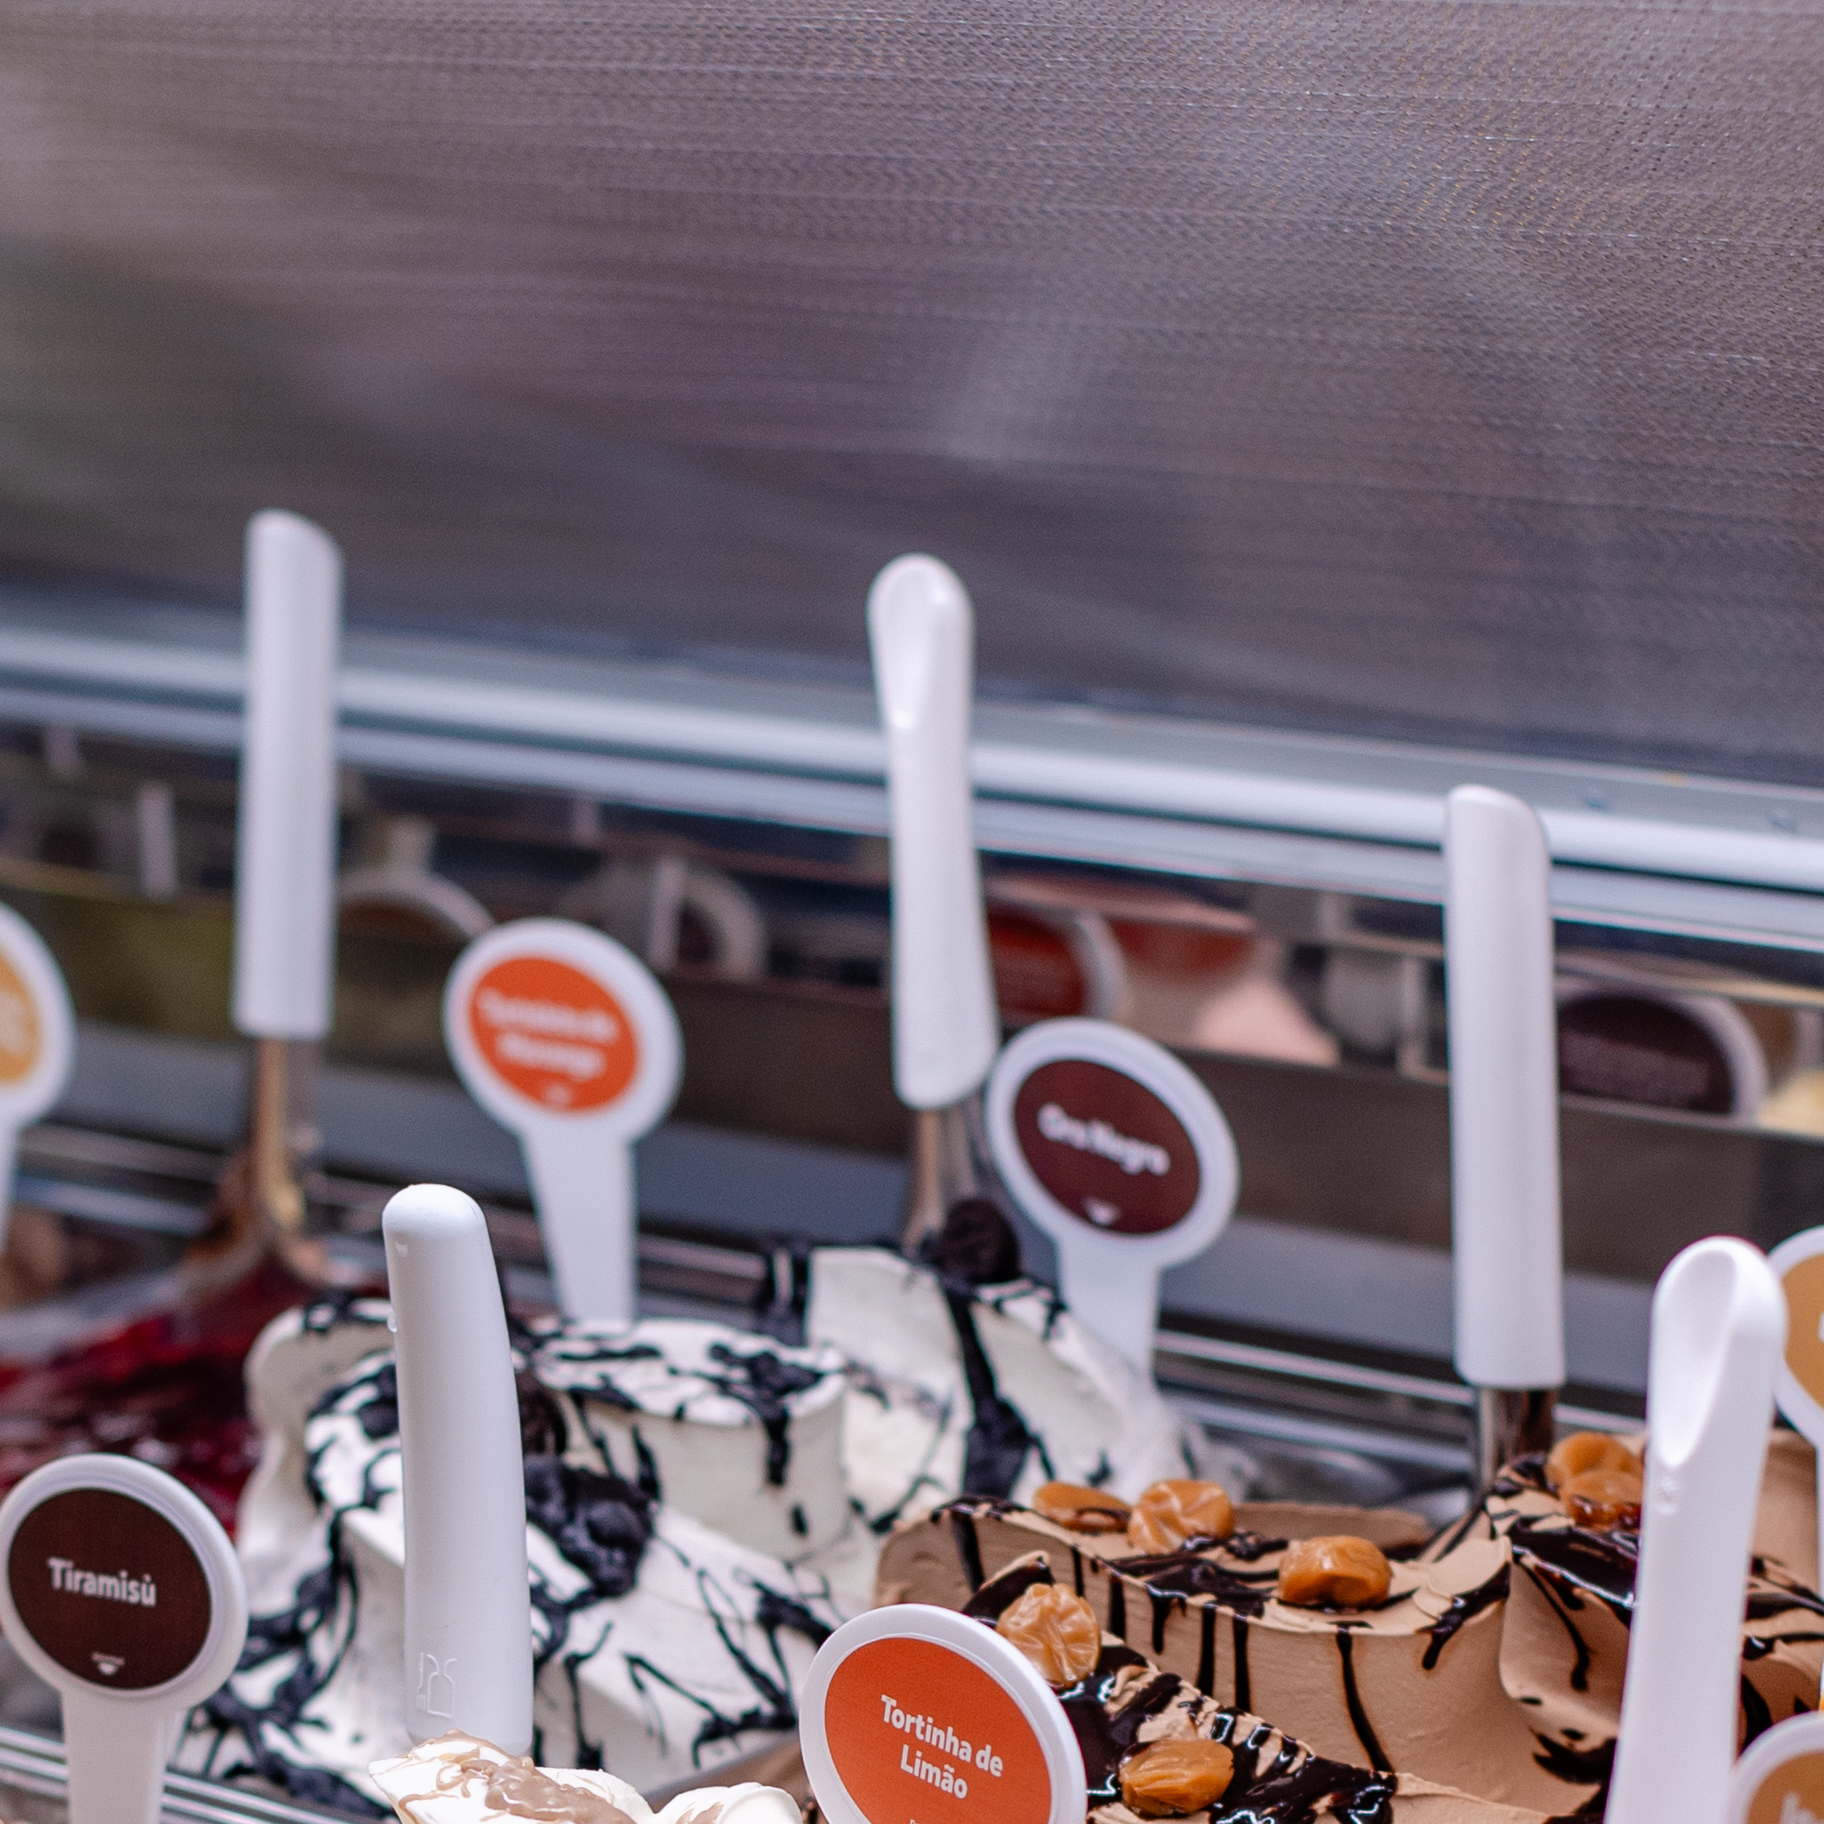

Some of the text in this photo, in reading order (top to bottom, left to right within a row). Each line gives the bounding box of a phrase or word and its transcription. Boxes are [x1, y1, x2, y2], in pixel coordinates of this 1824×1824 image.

[1087, 1118, 1171, 1176] Negro
[880, 1693, 1004, 1778] Tortinha de
[900, 1743, 968, 1799] Limão
